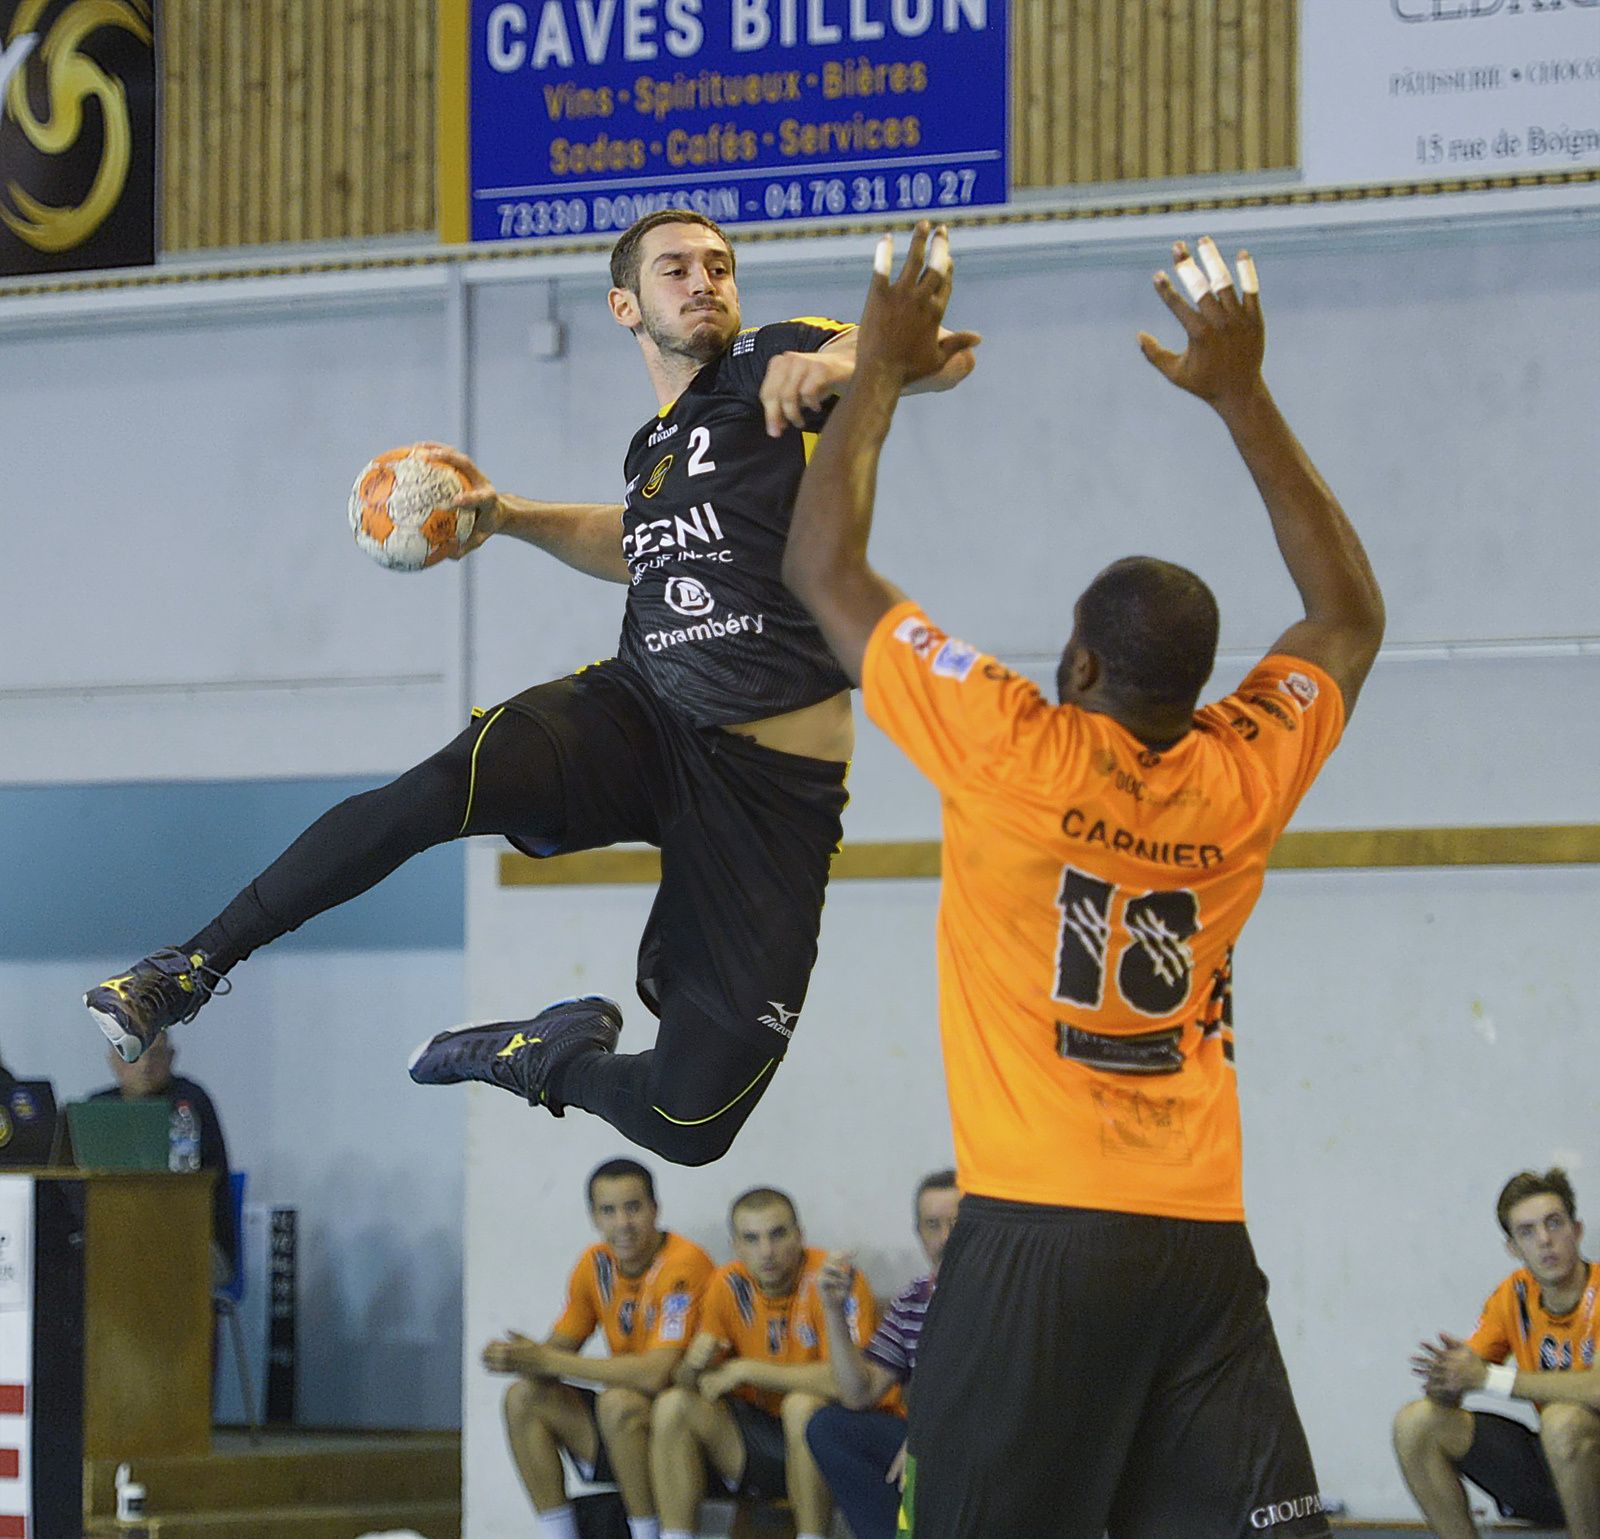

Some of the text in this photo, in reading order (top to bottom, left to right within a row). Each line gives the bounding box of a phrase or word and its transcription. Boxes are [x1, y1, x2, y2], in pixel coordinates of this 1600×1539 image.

[486, 0, 705, 73] CAVES
[543, 55, 928, 119] Vins Spiritueux Bières
[551, 112, 920, 176] Sodas Cafés Services
[1449, 137, 1487, 162] rue
[1491, 127, 1521, 159] de
[497, 198, 587, 237] 73330
[765, 182, 802, 218] 04
[808, 179, 846, 214] 76
[852, 176, 888, 211] 31
[896, 172, 932, 207] 10
[938, 169, 976, 204] 27
[687, 426, 716, 477] 2
[645, 613, 763, 652] Chambéry
[1050, 864, 1203, 1019] 18
